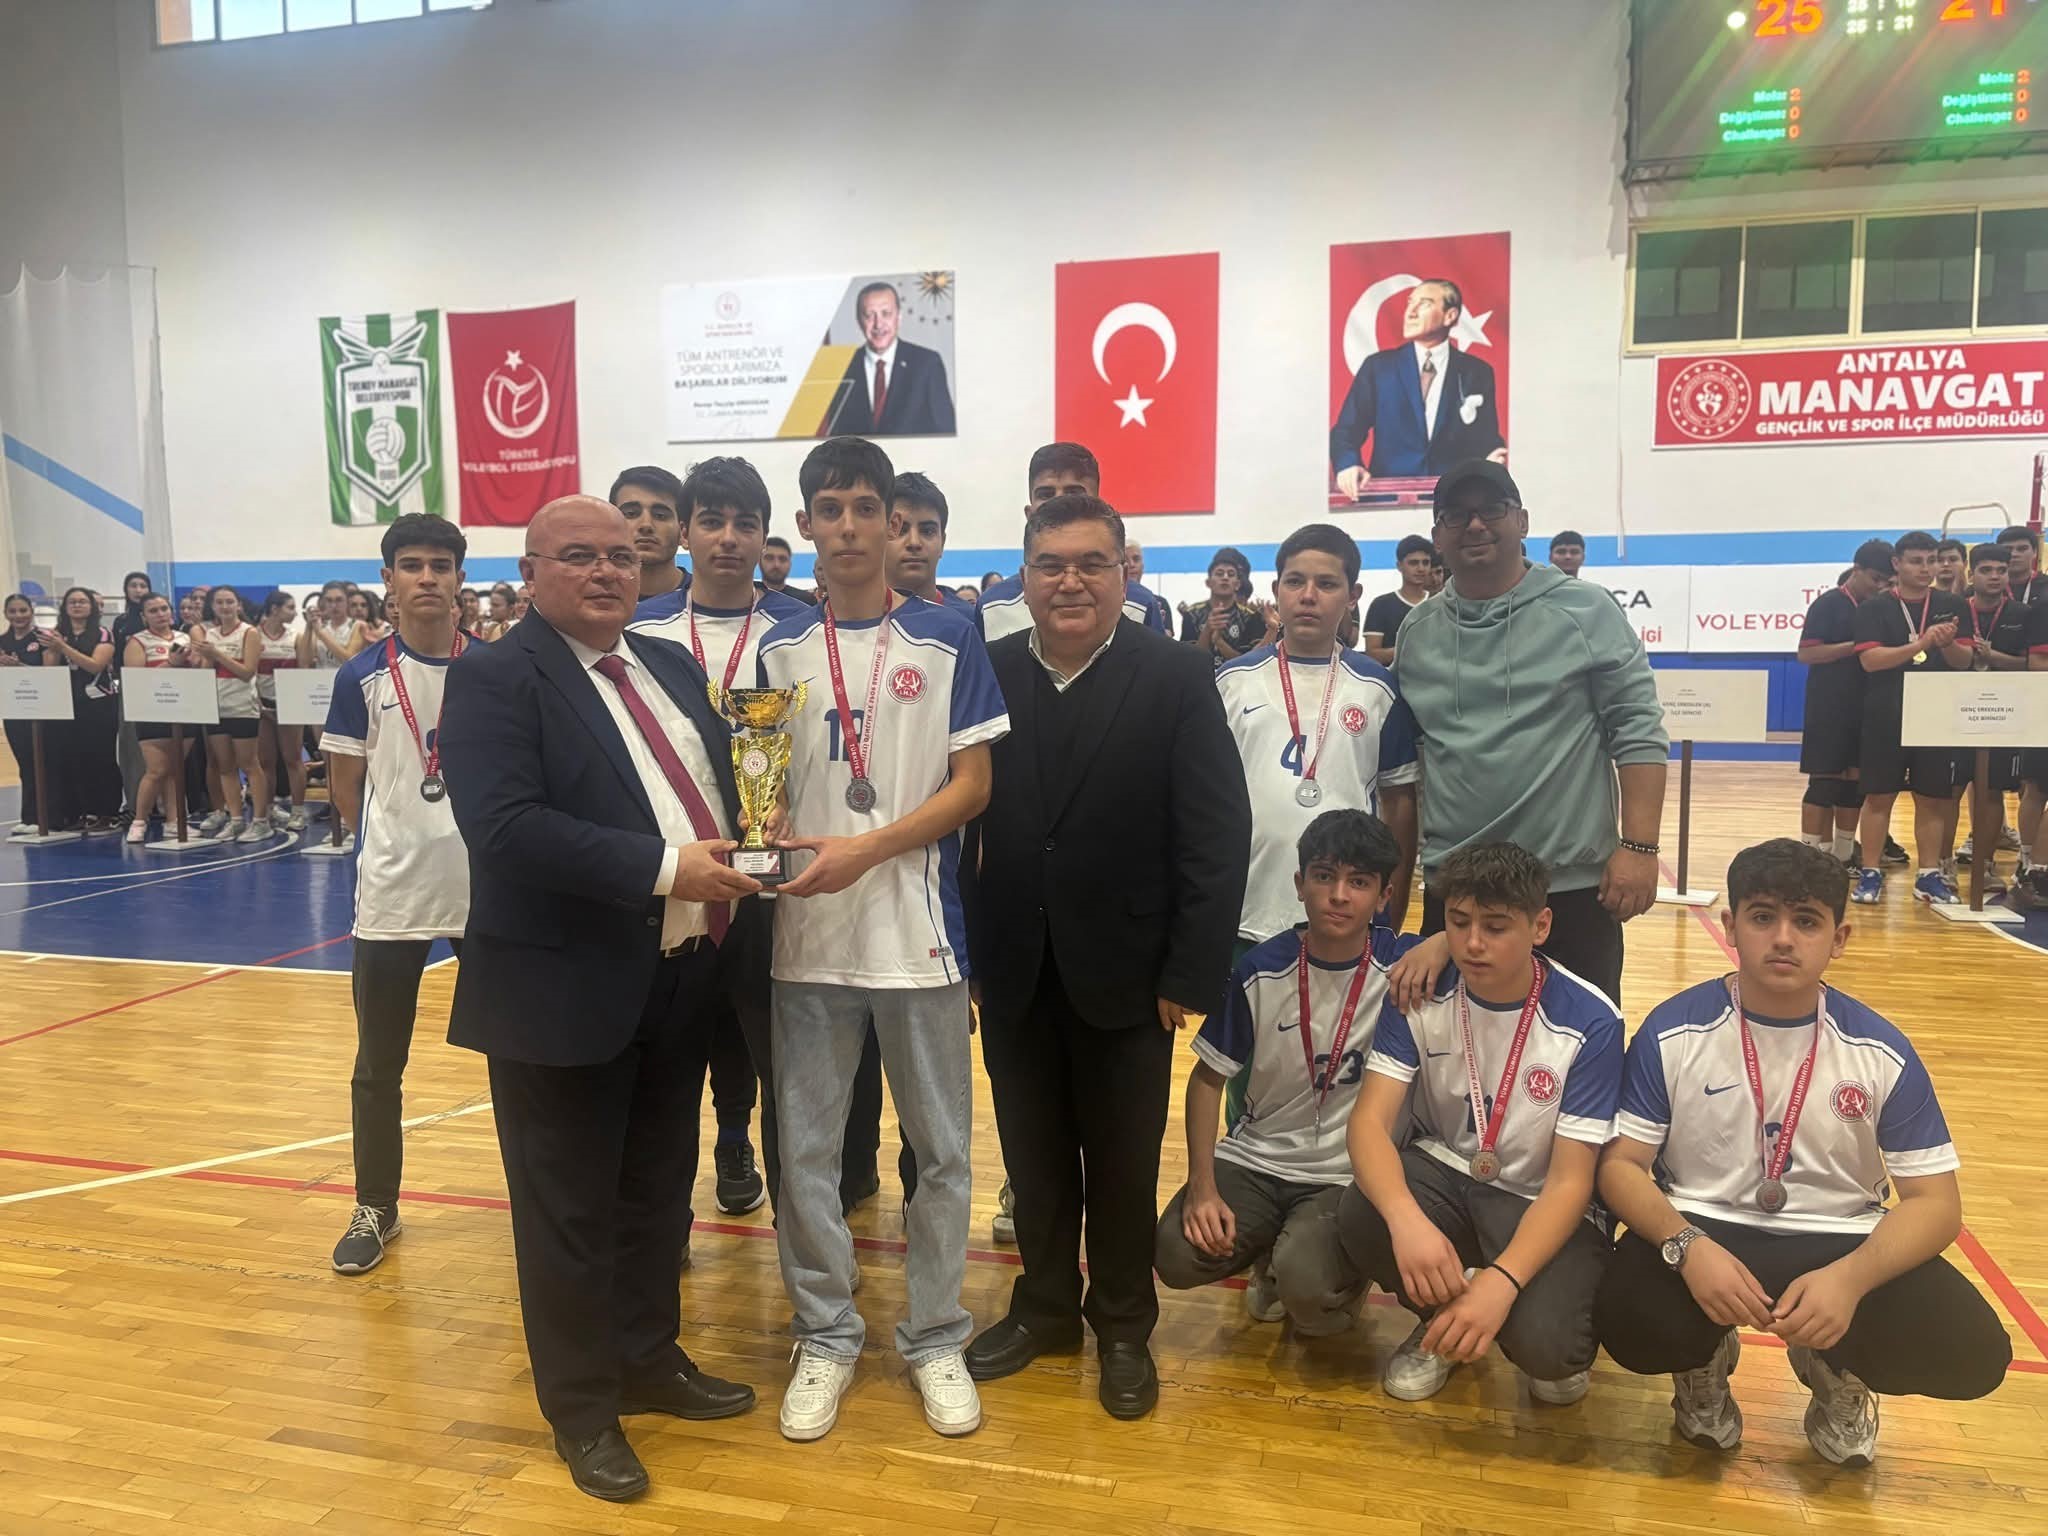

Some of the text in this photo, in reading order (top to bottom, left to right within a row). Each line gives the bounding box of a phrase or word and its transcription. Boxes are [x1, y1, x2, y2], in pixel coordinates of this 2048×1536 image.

[1755, 0, 1823, 37] 25
[1837, 349, 1967, 374] ANTALYA
[1759, 371, 2045, 416] MANAVGAT
[1756, 408, 2045, 437] GENÇLİK VE SPOR İLÇE MÜDÜRLÜĞÜ
[1280, 735, 1307, 776] 4
